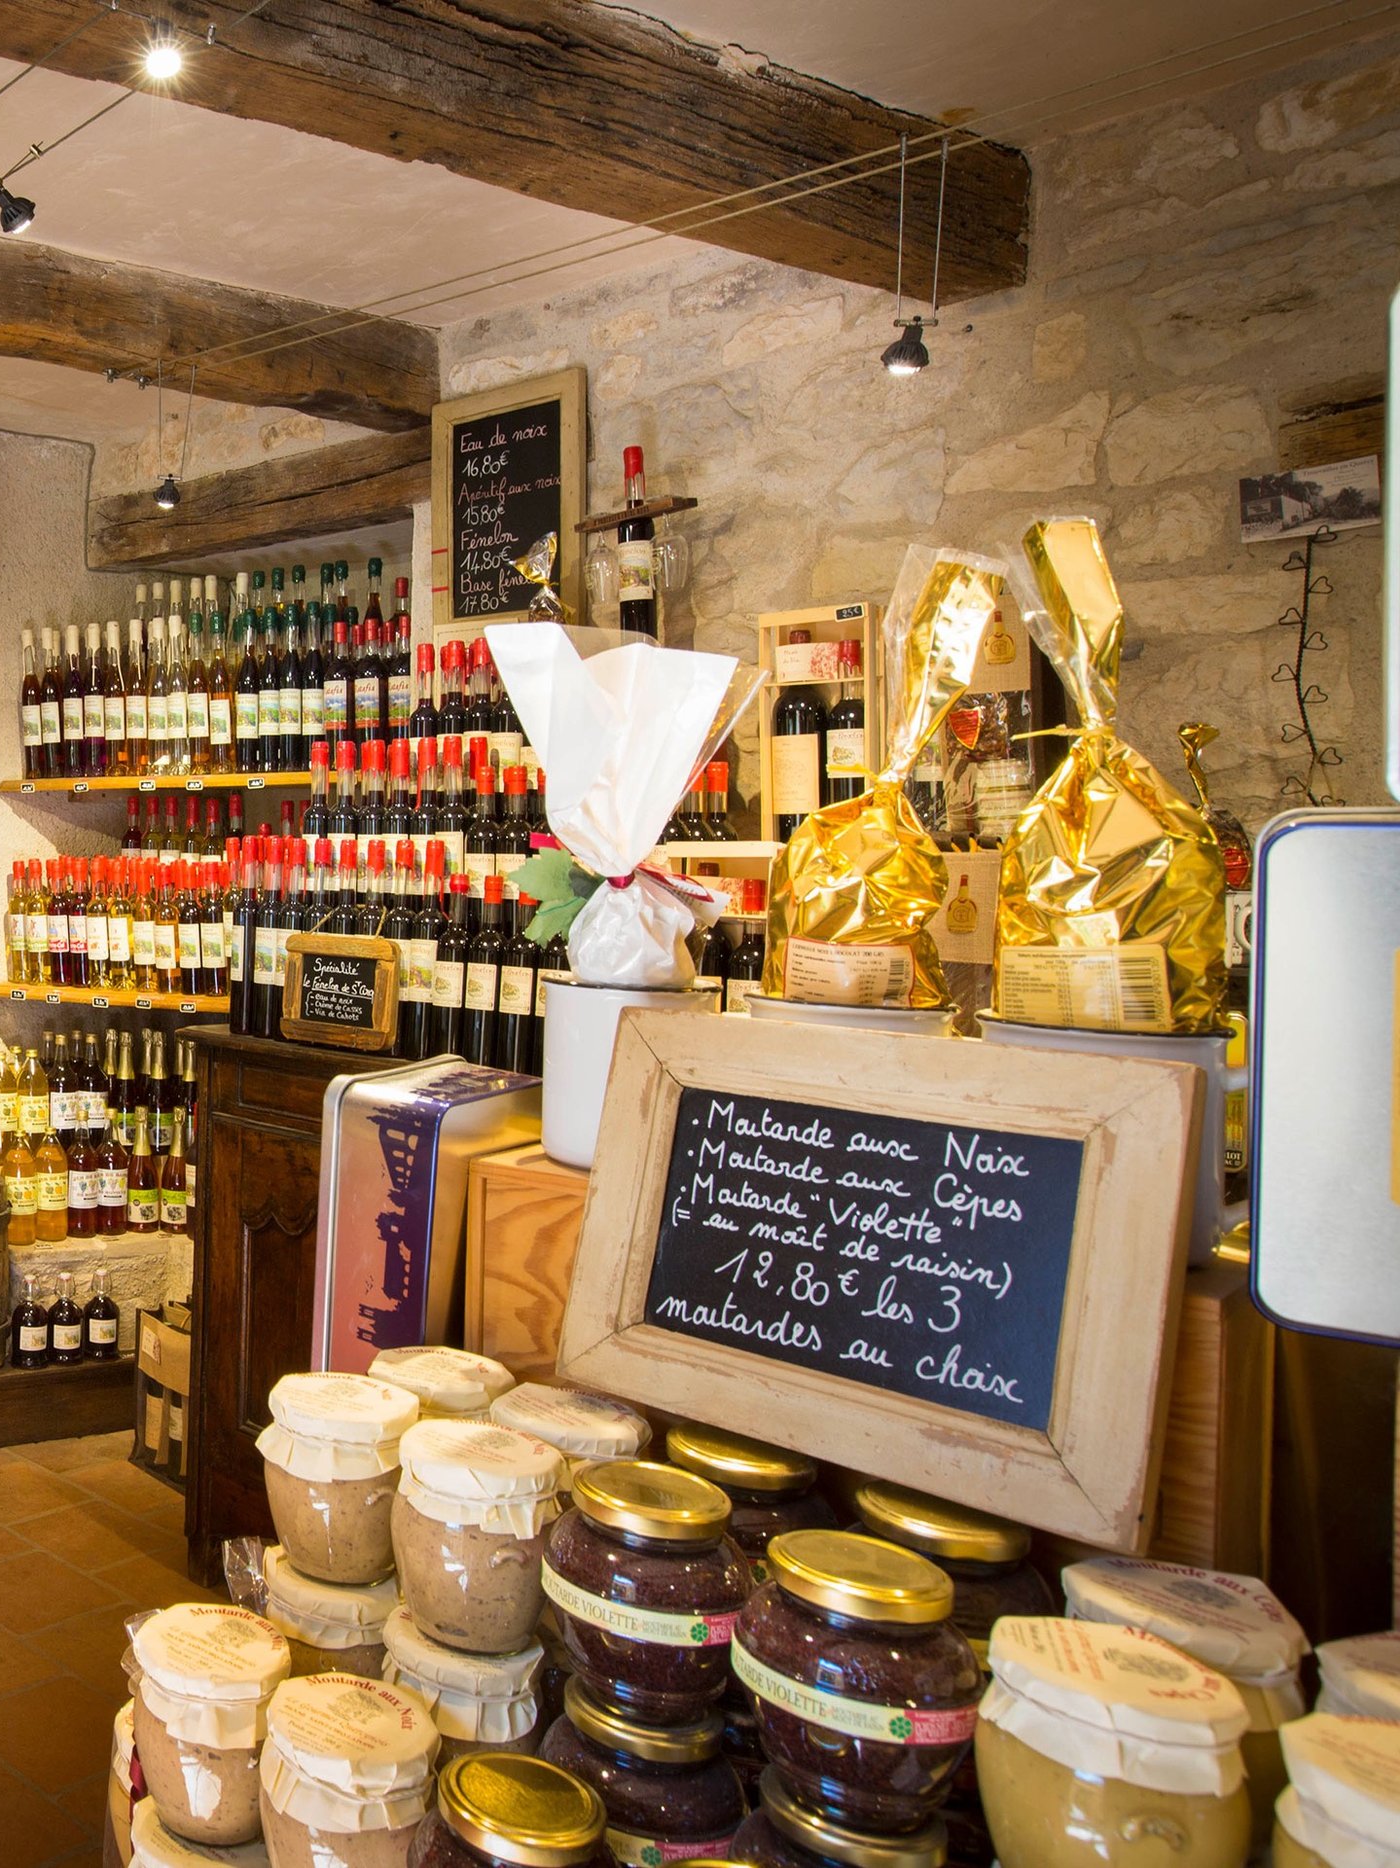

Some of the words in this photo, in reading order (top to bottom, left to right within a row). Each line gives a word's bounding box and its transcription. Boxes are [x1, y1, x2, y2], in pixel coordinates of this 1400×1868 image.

[460, 432, 483, 453] Eau
[488, 424, 507, 448] de
[512, 423, 548, 440] noix
[461, 450, 510, 478] 16,80€
[460, 521, 519, 551] Fénelon
[460, 573, 494, 594] Base
[313, 957, 360, 976] Spécialité
[312, 976, 340, 992] Fénelon
[341, 983, 350, 994] de
[330, 994, 337, 1003] de
[314, 1007, 326, 1016] Vin
[328, 1010, 335, 1018] de
[707, 1099, 835, 1149] Moutarde
[847, 1132, 919, 1162] aux
[944, 1131, 1030, 1177] Noix
[690, 1173, 807, 1219] Moutarde
[698, 1137, 829, 1184] Moutarde
[836, 1174, 911, 1197] aux
[933, 1172, 1023, 1231] Cèpes
[702, 1211, 740, 1233] au
[839, 1234, 880, 1262] de
[861, 1275, 915, 1325] les
[927, 1285, 962, 1333] 3
[656, 1290, 823, 1352] moutardes
[839, 1337, 894, 1369] au
[915, 1344, 1024, 1404] choix
[1107, 1558, 1207, 1580] Moutarde
[1213, 1574, 1249, 1596] aux
[189, 1606, 255, 1621] Moutarde
[255, 1617, 276, 1633] aux
[581, 1599, 639, 1632] VIOLETTE
[305, 1674, 377, 1692] Moutarde
[378, 1689, 404, 1707] aux
[397, 1706, 418, 1731] Noix
[765, 1676, 827, 1718] VIOLETTE
